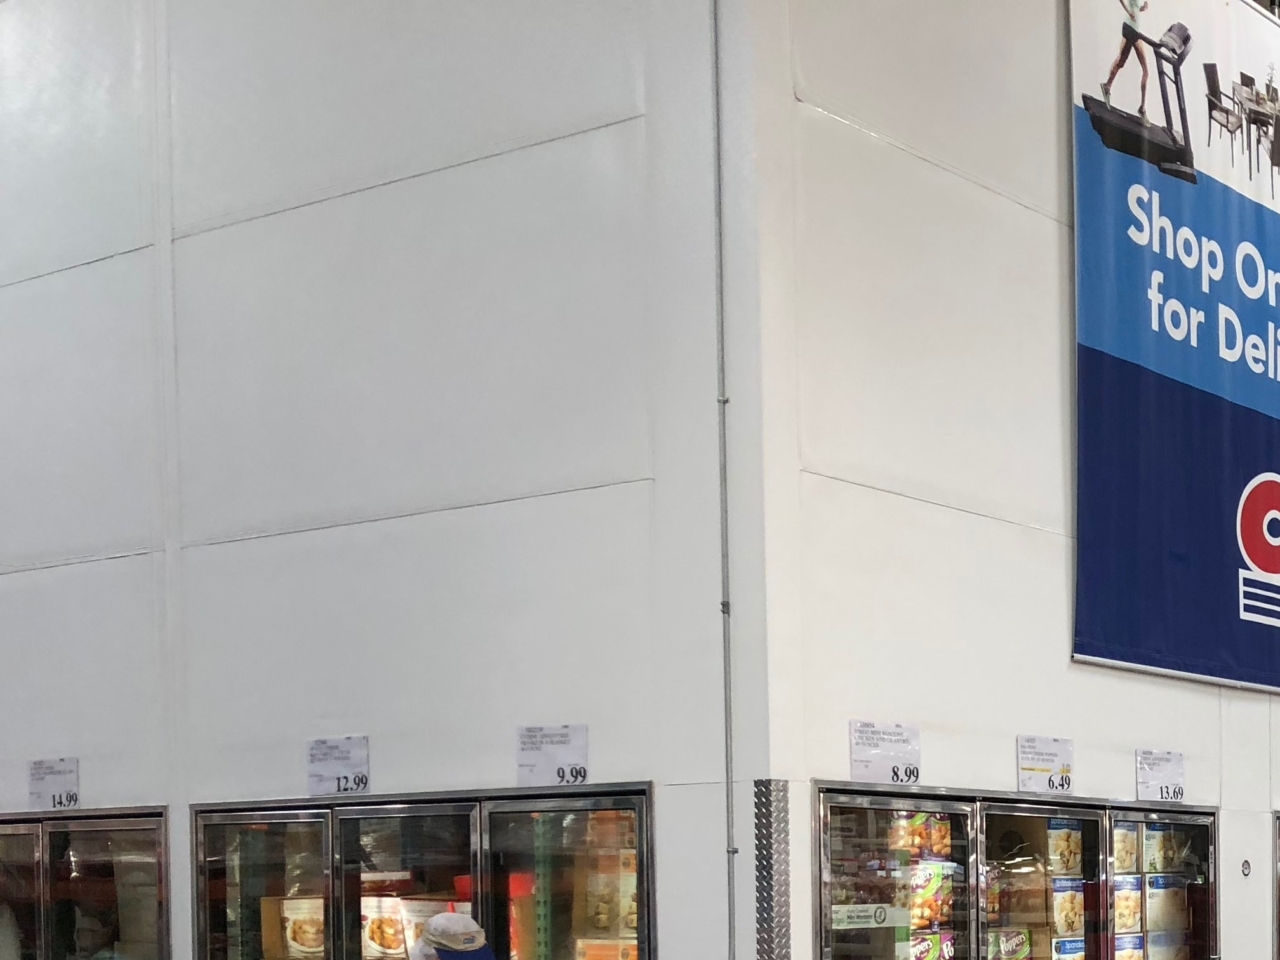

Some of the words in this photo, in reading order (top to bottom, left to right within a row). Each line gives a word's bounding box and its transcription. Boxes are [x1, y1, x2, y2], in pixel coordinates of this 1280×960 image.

[1127, 183, 1225, 293] Shop
[1147, 270, 1204, 348] for
[336, 774, 368, 793] 12.99
[557, 766, 587, 785] 9.99
[892, 765, 919, 783] 8.99
[1048, 774, 1071, 791] 6.49
[52, 792, 78, 809] 14.99
[1159, 786, 1184, 801] 13.69
[1000, 933, 1026, 955] Poppers
